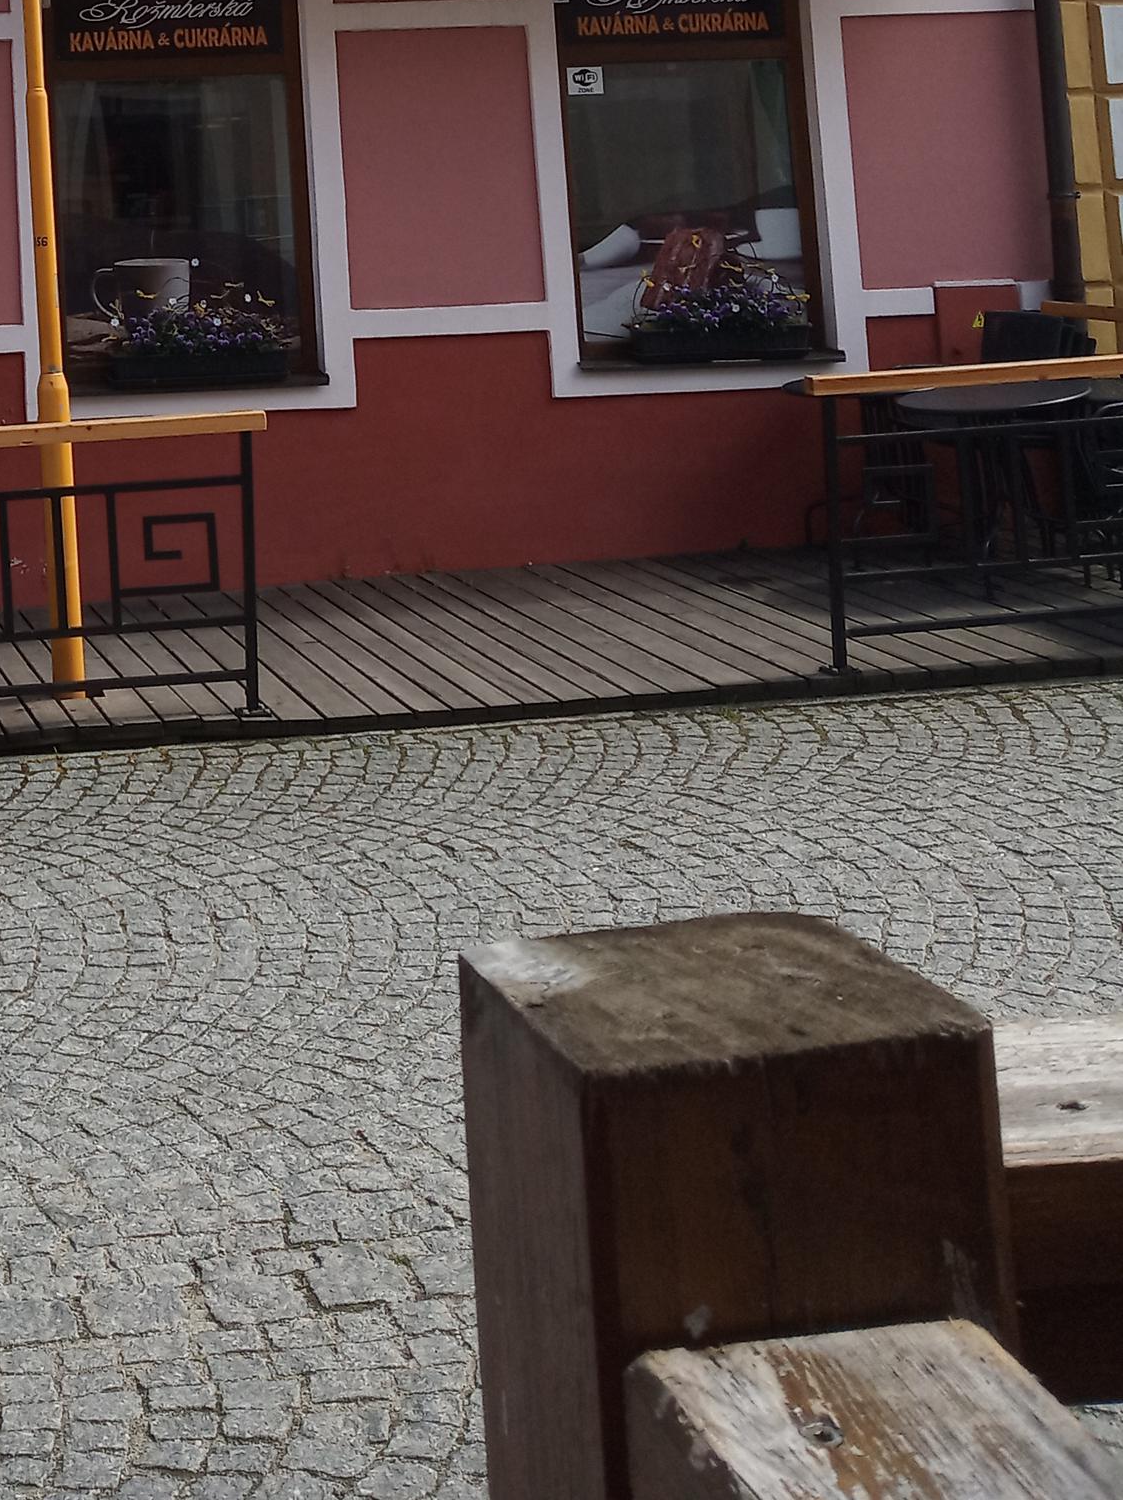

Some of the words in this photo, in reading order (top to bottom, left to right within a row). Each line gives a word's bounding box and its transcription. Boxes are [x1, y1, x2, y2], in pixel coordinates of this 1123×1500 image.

[69, 25, 155, 52] KAVÁRNA
[157, 33, 170, 47] &
[173, 21, 268, 49] CUKRÁRNA
[577, 11, 660, 36] KAVÁRNA
[662, 18, 675, 31] &
[678, 8, 770, 34] CUKRÁRNA
